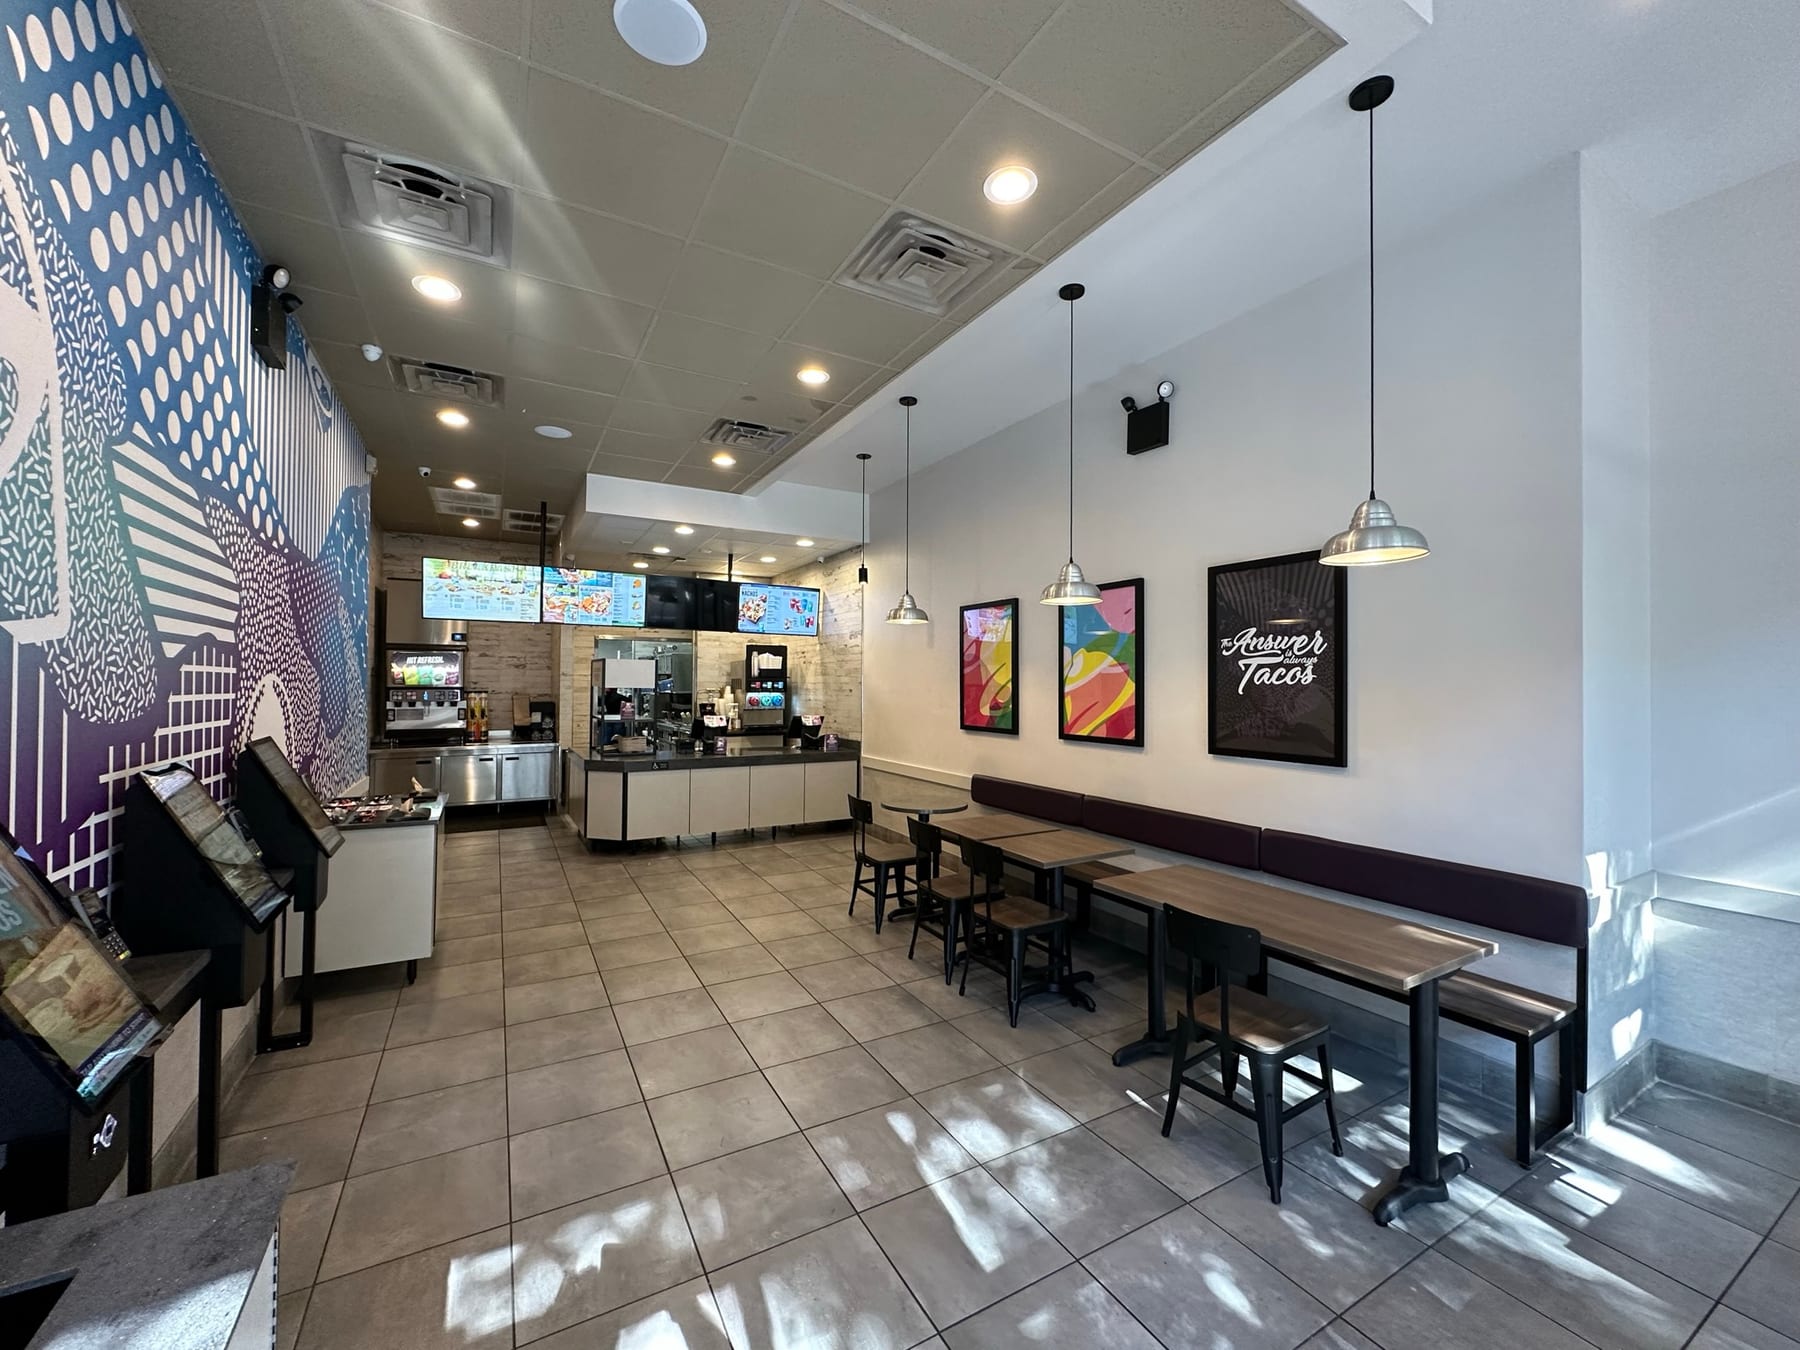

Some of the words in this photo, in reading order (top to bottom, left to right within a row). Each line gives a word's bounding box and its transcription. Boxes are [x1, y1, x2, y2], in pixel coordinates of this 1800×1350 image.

[1220, 638, 1233, 649] The
[1222, 627, 1328, 656] Answer
[1284, 648, 1293, 657] is
[1283, 656, 1318, 667] always
[1238, 655, 1318, 695] Tacos
